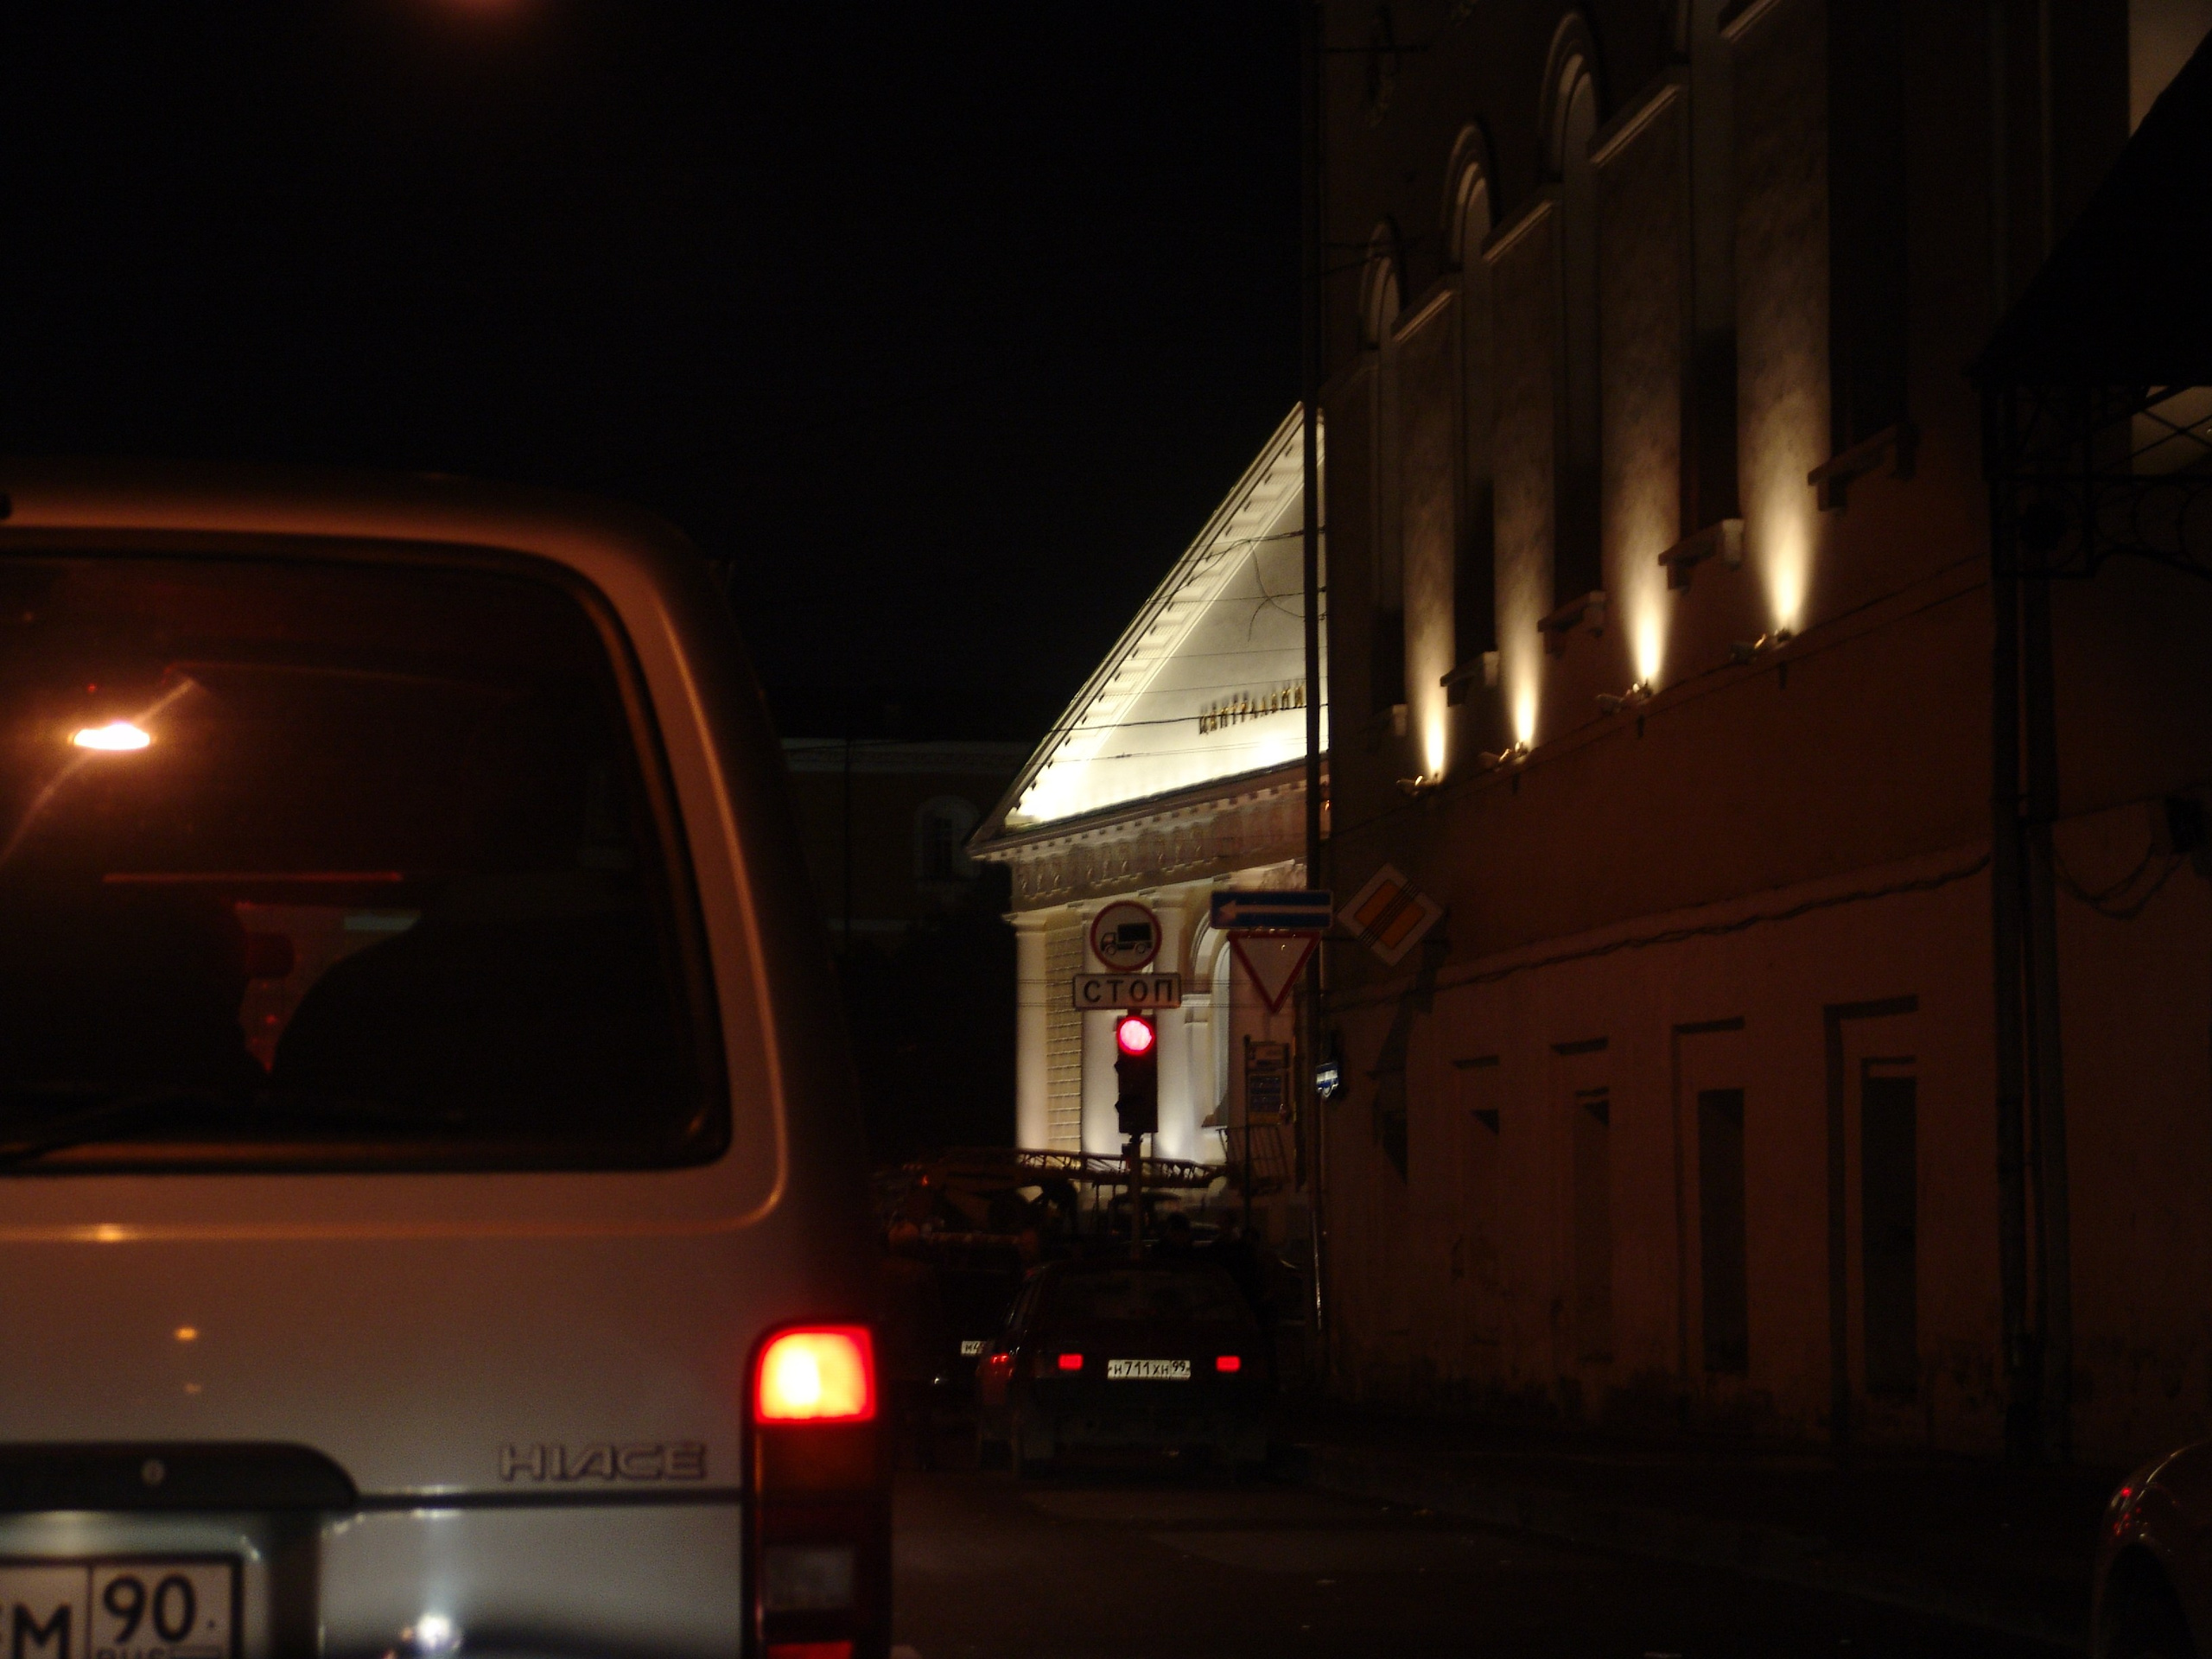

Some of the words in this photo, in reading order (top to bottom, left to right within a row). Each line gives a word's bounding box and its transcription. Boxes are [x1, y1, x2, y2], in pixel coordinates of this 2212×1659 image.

[1084, 978, 1173, 1003] СТОП
[493, 1442, 706, 1482] HIACE
[0, 1604, 72, 1659] М
[103, 1574, 196, 1643] 90
